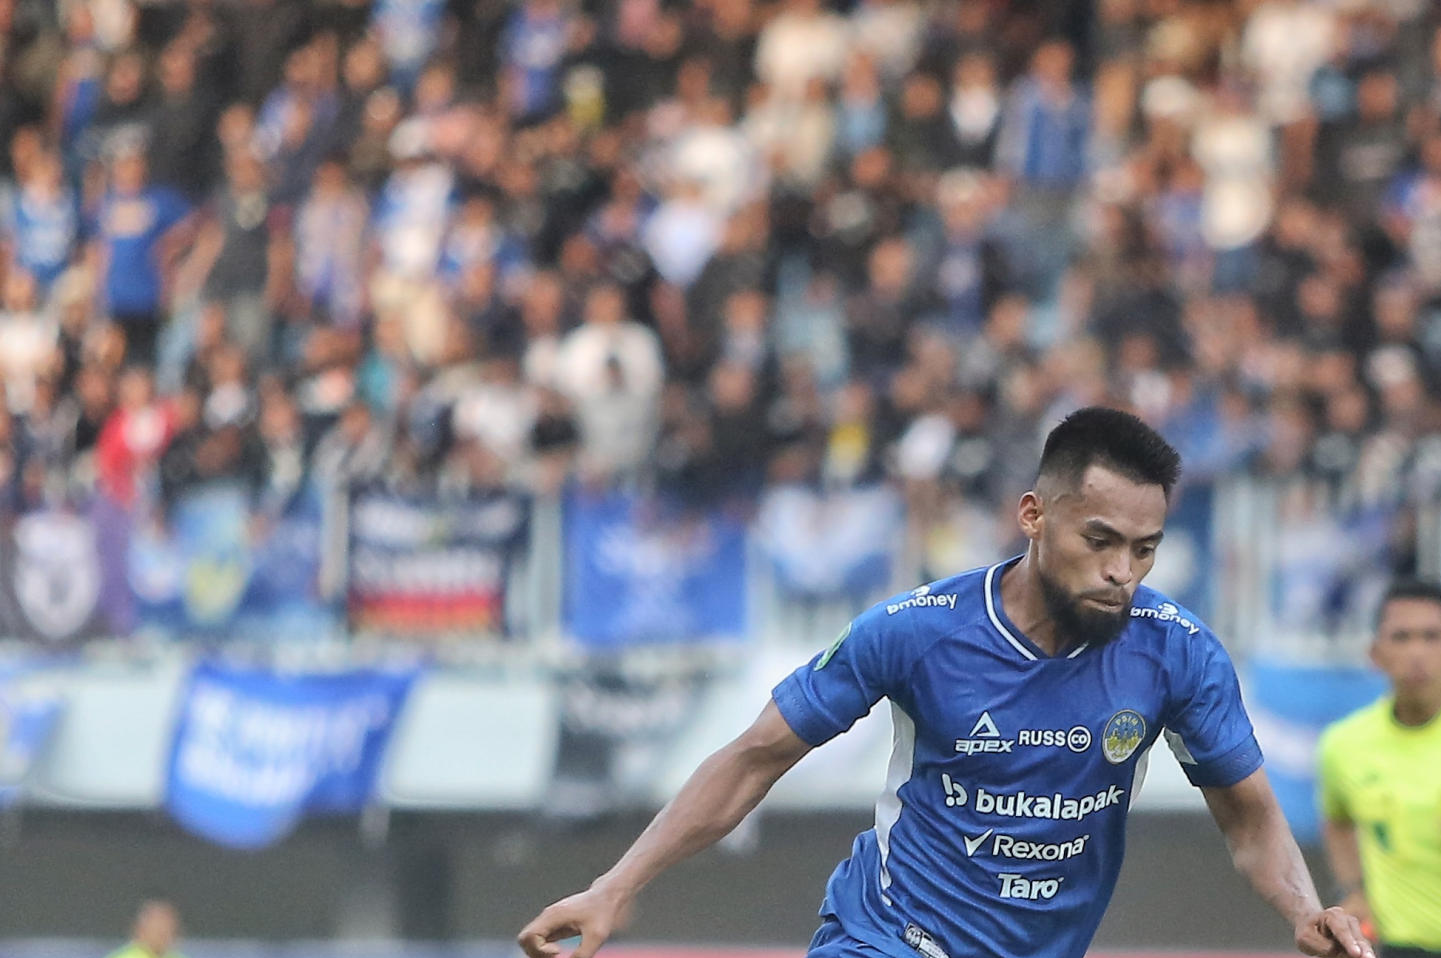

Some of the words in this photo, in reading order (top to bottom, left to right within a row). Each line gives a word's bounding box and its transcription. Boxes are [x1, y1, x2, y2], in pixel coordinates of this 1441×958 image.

[887, 592, 957, 615] bmoney
[1130, 606, 1200, 635] bmoney
[955, 739, 1015, 756] apex
[975, 785, 1124, 820] bukalapak
[992, 835, 1085, 860] Rexona
[998, 873, 1058, 900] Taro
